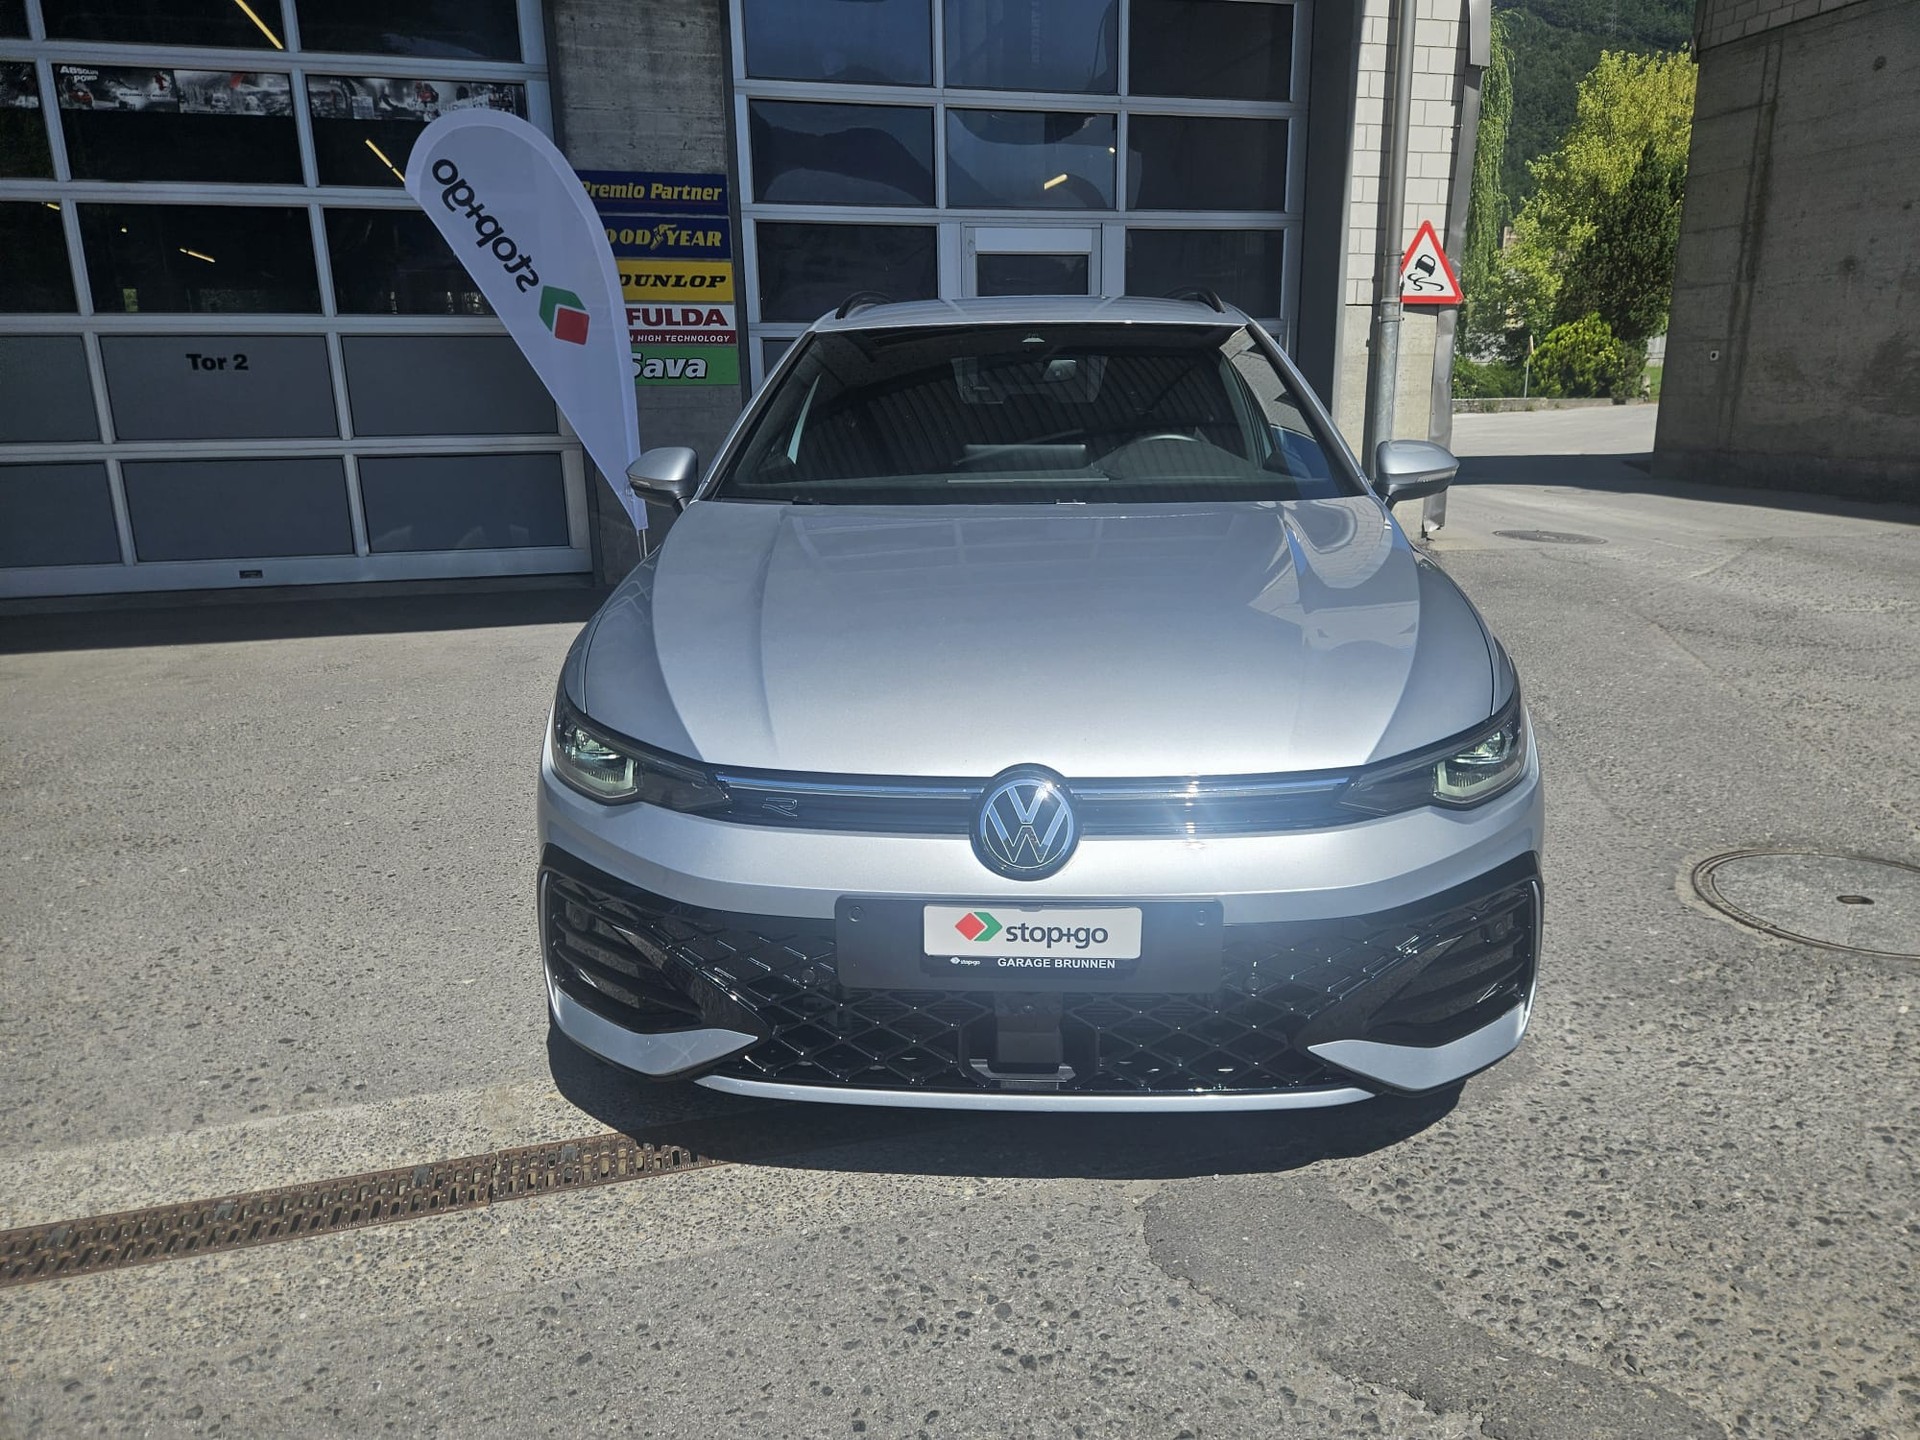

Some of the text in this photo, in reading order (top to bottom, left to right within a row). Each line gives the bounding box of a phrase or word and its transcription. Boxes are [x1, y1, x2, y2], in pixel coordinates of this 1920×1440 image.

[650, 182, 722, 201] Partner
[606, 228, 722, 248] OODYEAR
[619, 273, 727, 289] DUNLOP
[626, 308, 729, 327] FULDA
[637, 334, 662, 343] HIGH
[665, 334, 730, 343] TECHNOLOGY
[185, 353, 249, 371] Tor 2
[632, 352, 707, 379] Sava
[1005, 922, 1109, 949] stop+go
[997, 958, 1115, 969] GARAGE BRUNNEN
